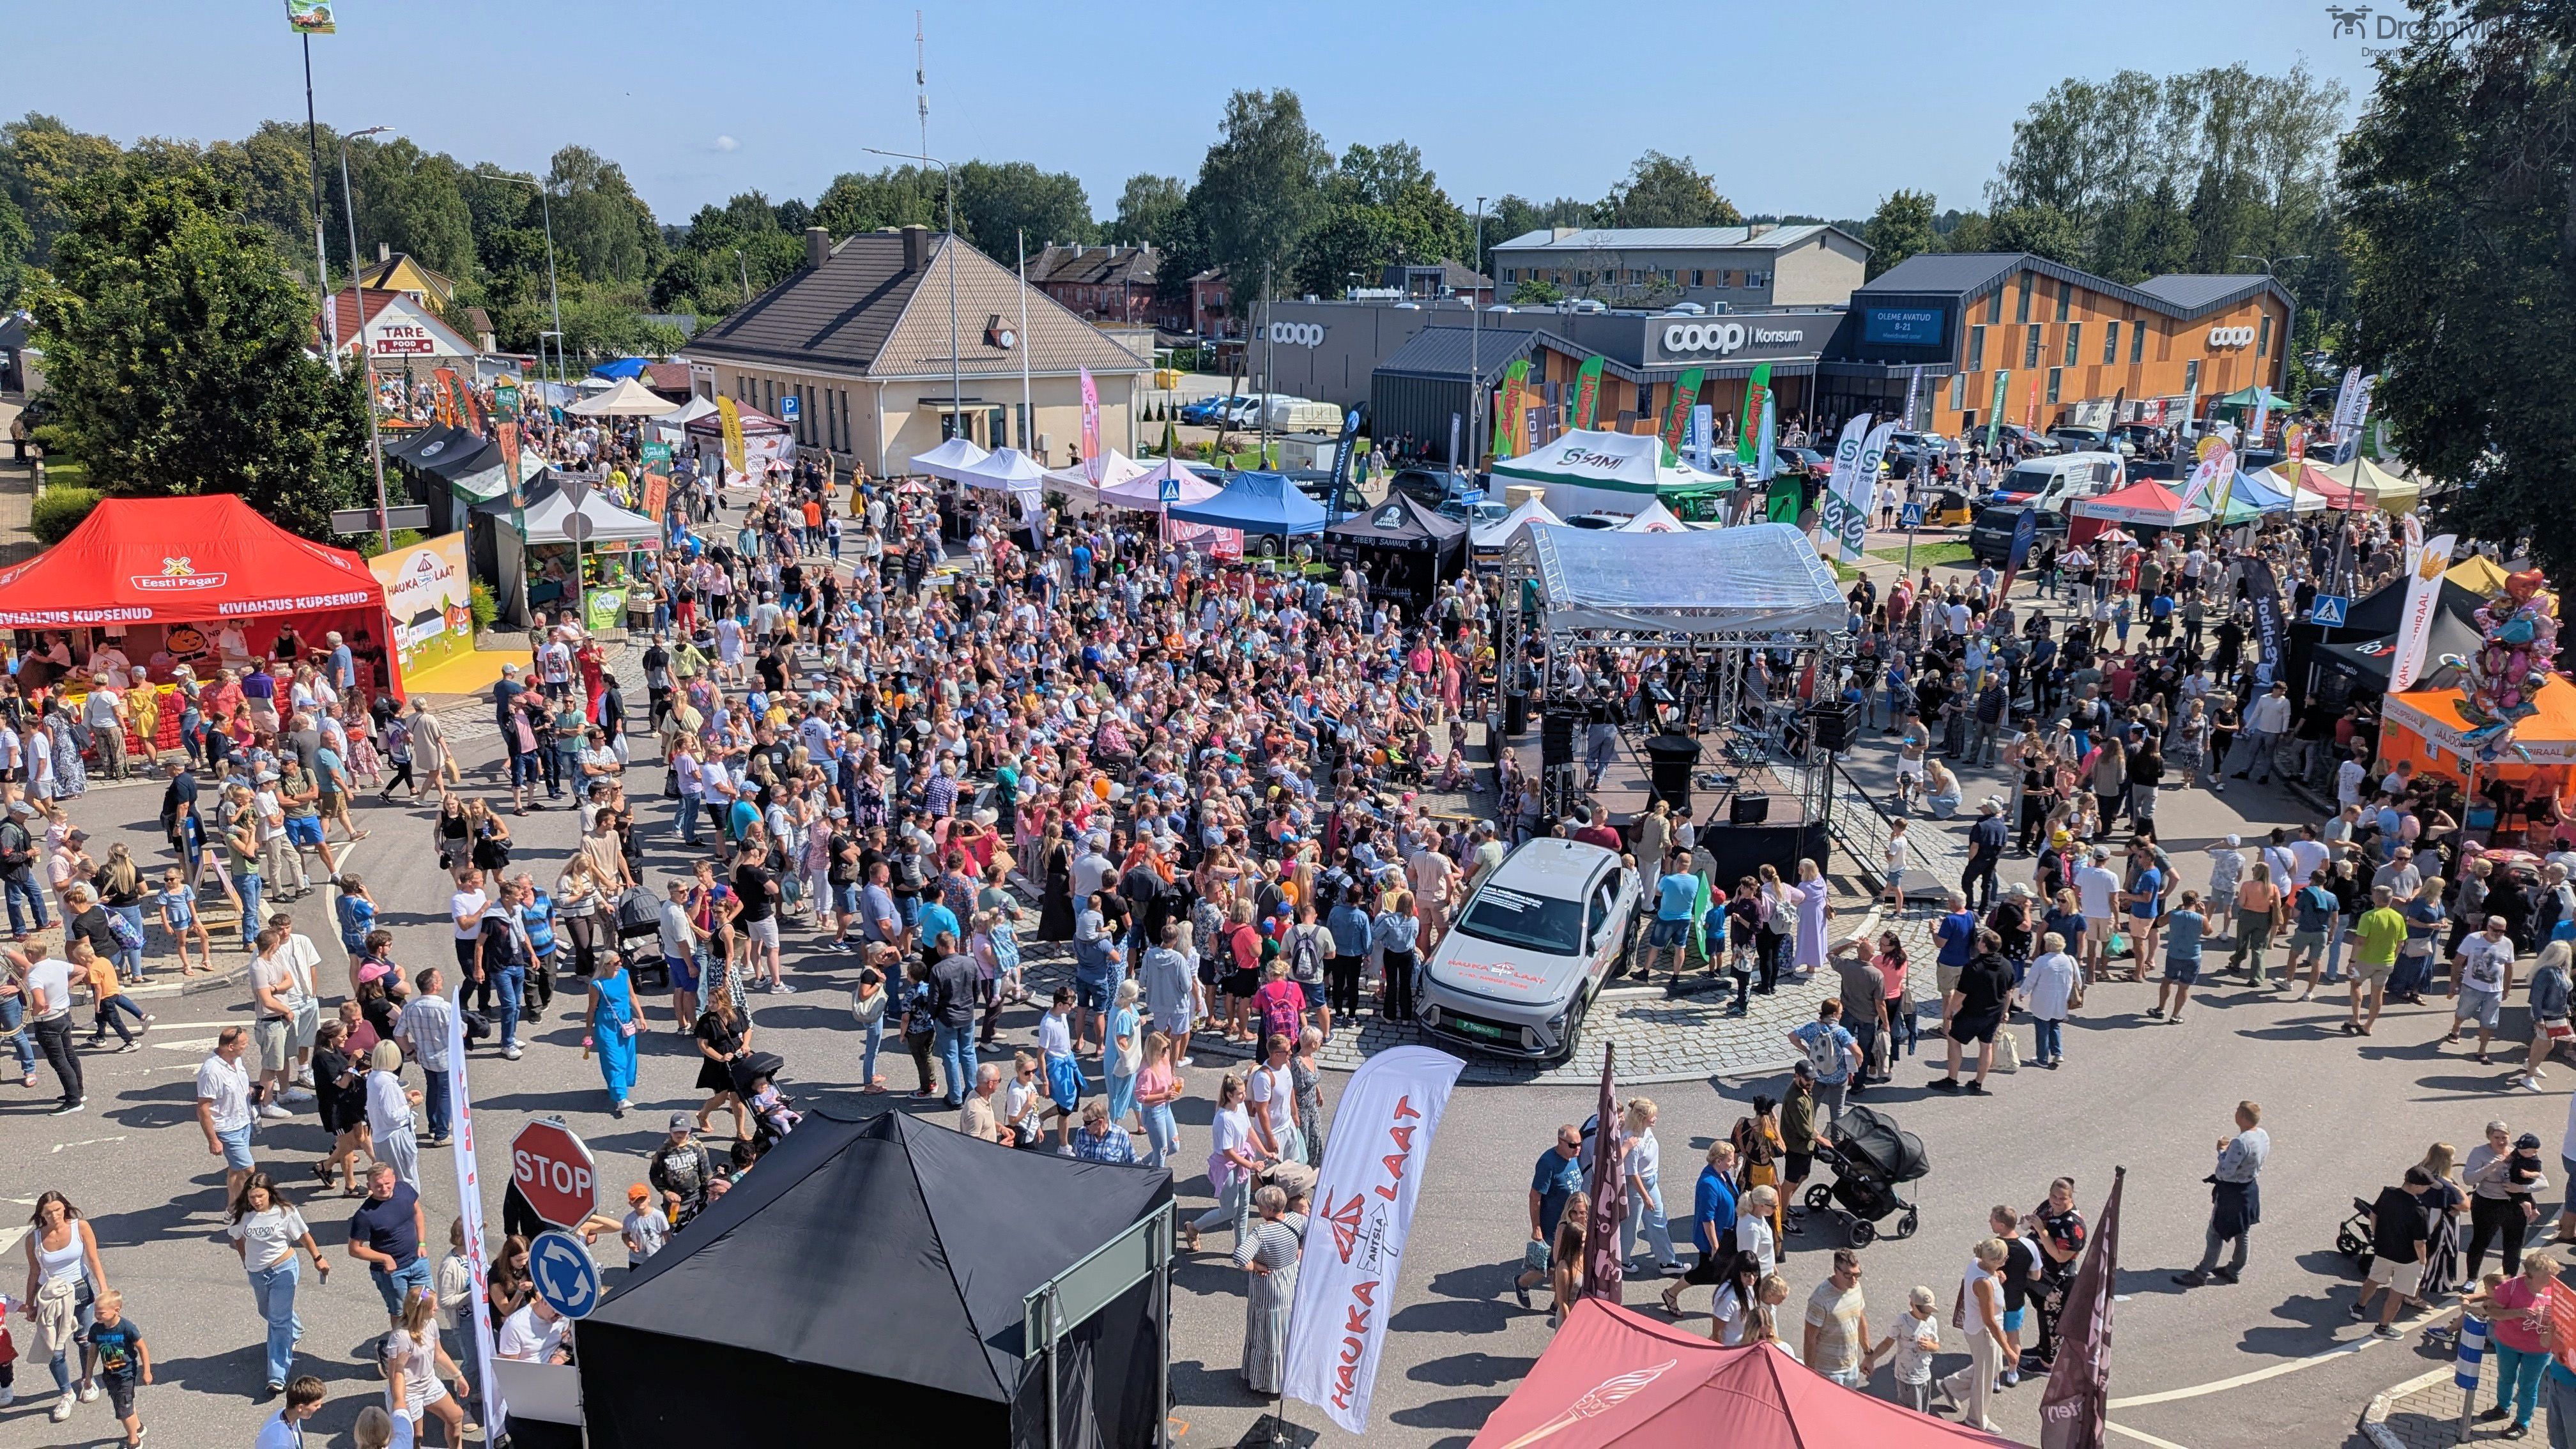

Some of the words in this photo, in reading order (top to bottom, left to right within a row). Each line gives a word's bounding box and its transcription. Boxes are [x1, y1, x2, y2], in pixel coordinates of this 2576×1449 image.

[1903, 313, 1931, 321] AVATUD
[383, 327, 424, 338] TARE
[1271, 322, 1324, 349] coop
[1664, 323, 1745, 354] coop
[1754, 327, 1803, 344] Konsum
[2209, 326, 2255, 347] coop
[786, 399, 794, 411] P
[1666, 385, 1696, 455] AVANT
[1579, 453, 1623, 470] SAMI
[1379, 538, 1411, 549] SAMMAR
[142, 578, 176, 588] Eesti
[179, 576, 219, 588] Pagar
[388, 578, 419, 597] HAUKA
[434, 565, 456, 581] LAAT
[218, 599, 293, 615] KIVIAHJUS
[296, 592, 369, 609] KÜPSENUD
[0, 610, 69, 625] IVIAHJUS
[73, 608, 153, 622] KÜPSENUD
[1470, 1023, 1494, 1034] Topauto
[1375, 1094, 1422, 1202] LAAT
[515, 1148, 592, 1199] STOP
[1368, 1216, 1384, 1263] ANTSLA
[1331, 1280, 1379, 1410] HAUKA
